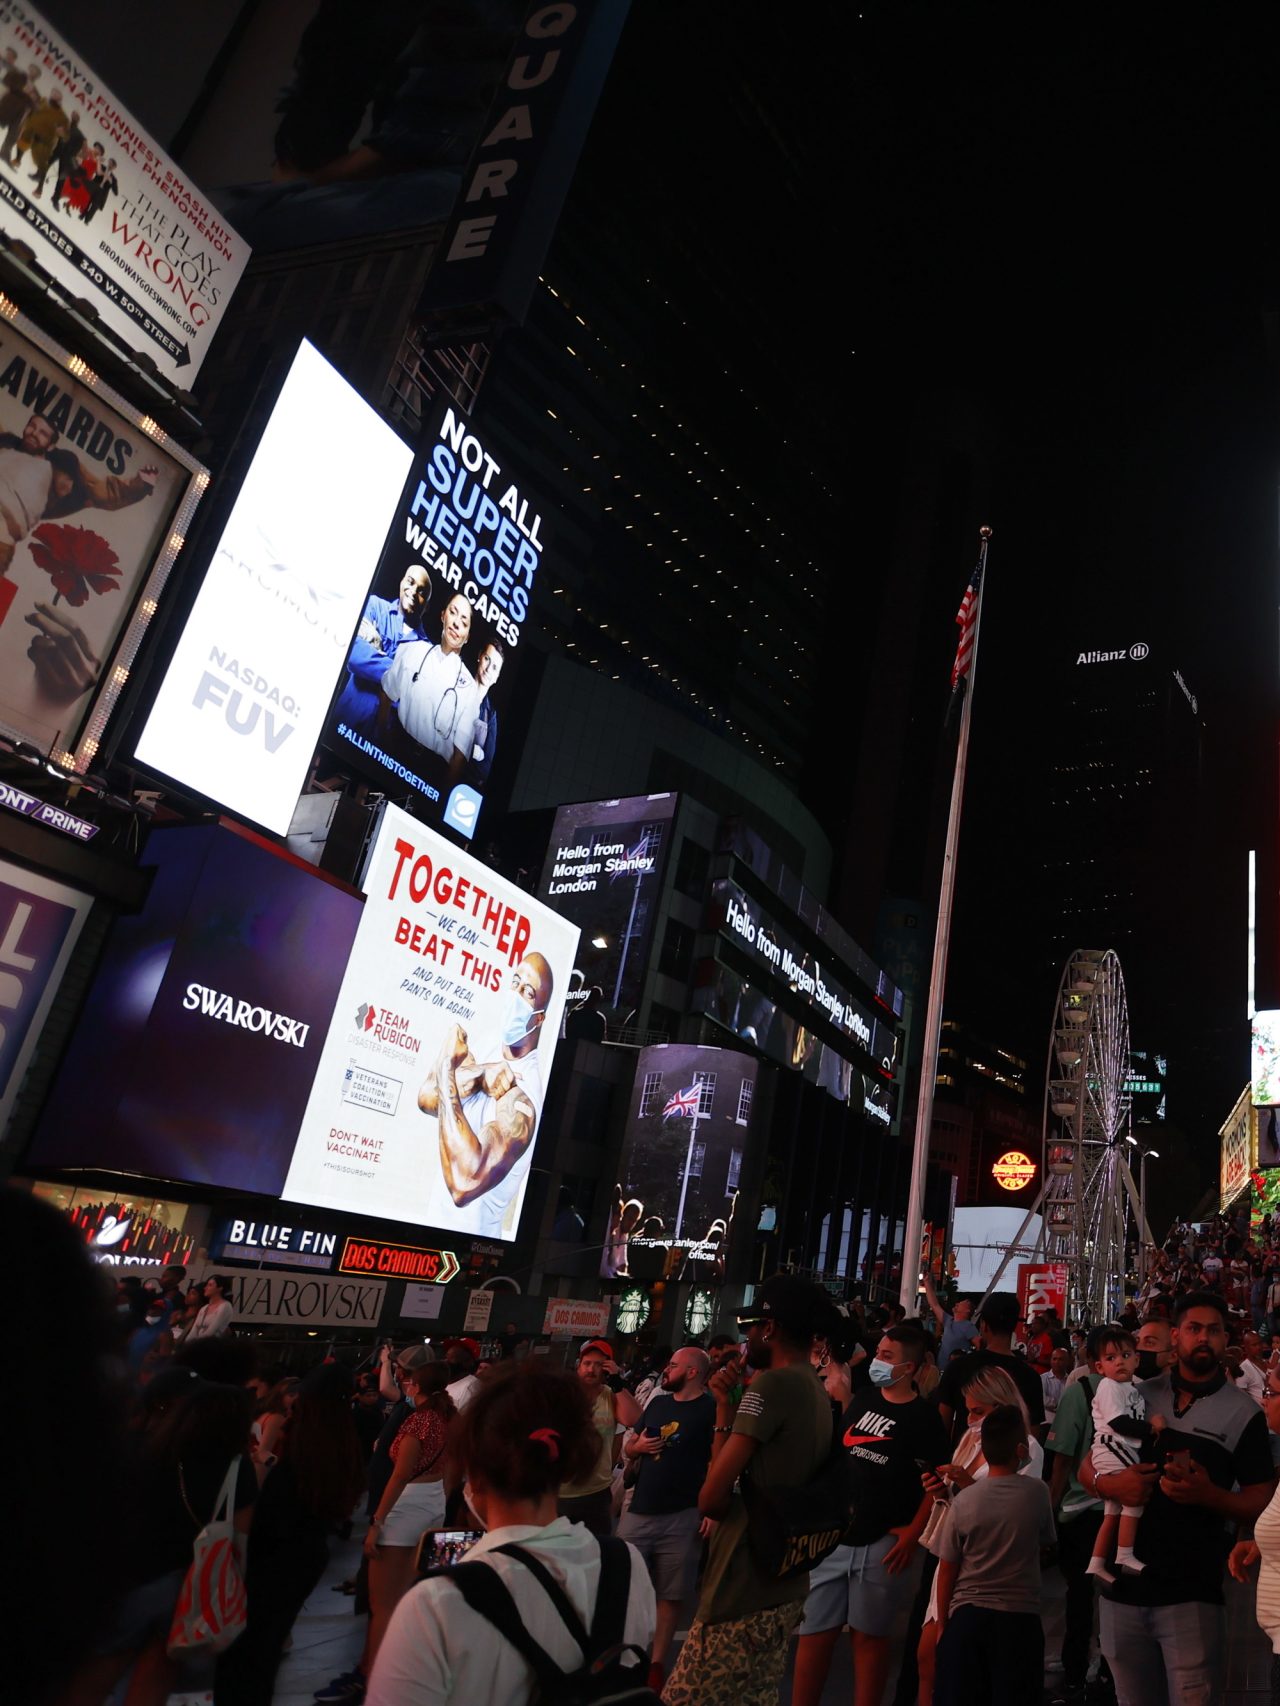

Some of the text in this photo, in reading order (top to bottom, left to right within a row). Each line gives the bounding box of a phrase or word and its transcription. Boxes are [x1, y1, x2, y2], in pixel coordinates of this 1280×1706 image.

[15, 26, 232, 261] INTERNATIONAL PHENOMENON
[97, 96, 162, 168] FUNNIEST
[166, 171, 208, 220] SMASH
[210, 219, 232, 243] HIT
[121, 195, 220, 306] THAT GOES
[137, 190, 221, 277] THE PLAY
[26, 210, 74, 256] STAGES
[80, 260, 104, 283] 340
[105, 281, 119, 300] W.
[143, 318, 182, 356] STREET
[99, 241, 198, 338] BROADWAYGOESWRONG.COM
[112, 211, 211, 327] WRONG
[0, 355, 133, 476] AWARDS
[440, 408, 544, 552] NOT ALL
[428, 444, 538, 589] SUPER
[411, 480, 529, 623] HEROES
[405, 517, 520, 647] WEAR CAPES
[1076, 650, 1127, 665] Allianz
[208, 646, 301, 718] NASDAQ:
[192, 671, 295, 753] FUV
[337, 724, 440, 802] #ALLINTHISTOGETHER
[41, 806, 92, 838] PRIME
[552, 857, 654, 878] Morgan Stanley
[556, 843, 625, 860] Hello from
[388, 838, 531, 968] TOGETHER
[548, 879, 597, 895] London
[438, 914, 479, 946] WE CAN
[395, 917, 502, 992] BEAT THIS
[725, 899, 756, 942] Hello
[756, 927, 780, 965] from
[781, 949, 815, 995] Morgan
[815, 979, 845, 1023] Stanley
[400, 979, 476, 1021] PANTS ON AGAIN!
[412, 966, 475, 1003] AND PUT REAL
[566, 989, 591, 1001] anley
[183, 983, 310, 1048] SWAROVSKI
[380, 1008, 409, 1031] TEAM
[374, 1024, 421, 1053] RUBICON
[351, 1091, 391, 1109] VACCINATION
[353, 1081, 386, 1098] COALITION
[355, 1073, 388, 1089] VETERANS
[327, 1142, 382, 1164] VACCINATE.
[330, 1128, 358, 1144] DON'T
[229, 1220, 336, 1255] BLUE FIN
[345, 1243, 377, 1269] DOS
[377, 1247, 440, 1278] CAMINOS
[230, 1276, 382, 1320] WAROVSKI
[555, 1310, 601, 1327] DOS CAMINOS
[855, 1410, 896, 1438] NIKE
[850, 1446, 889, 1465] SPORTSWEAR
